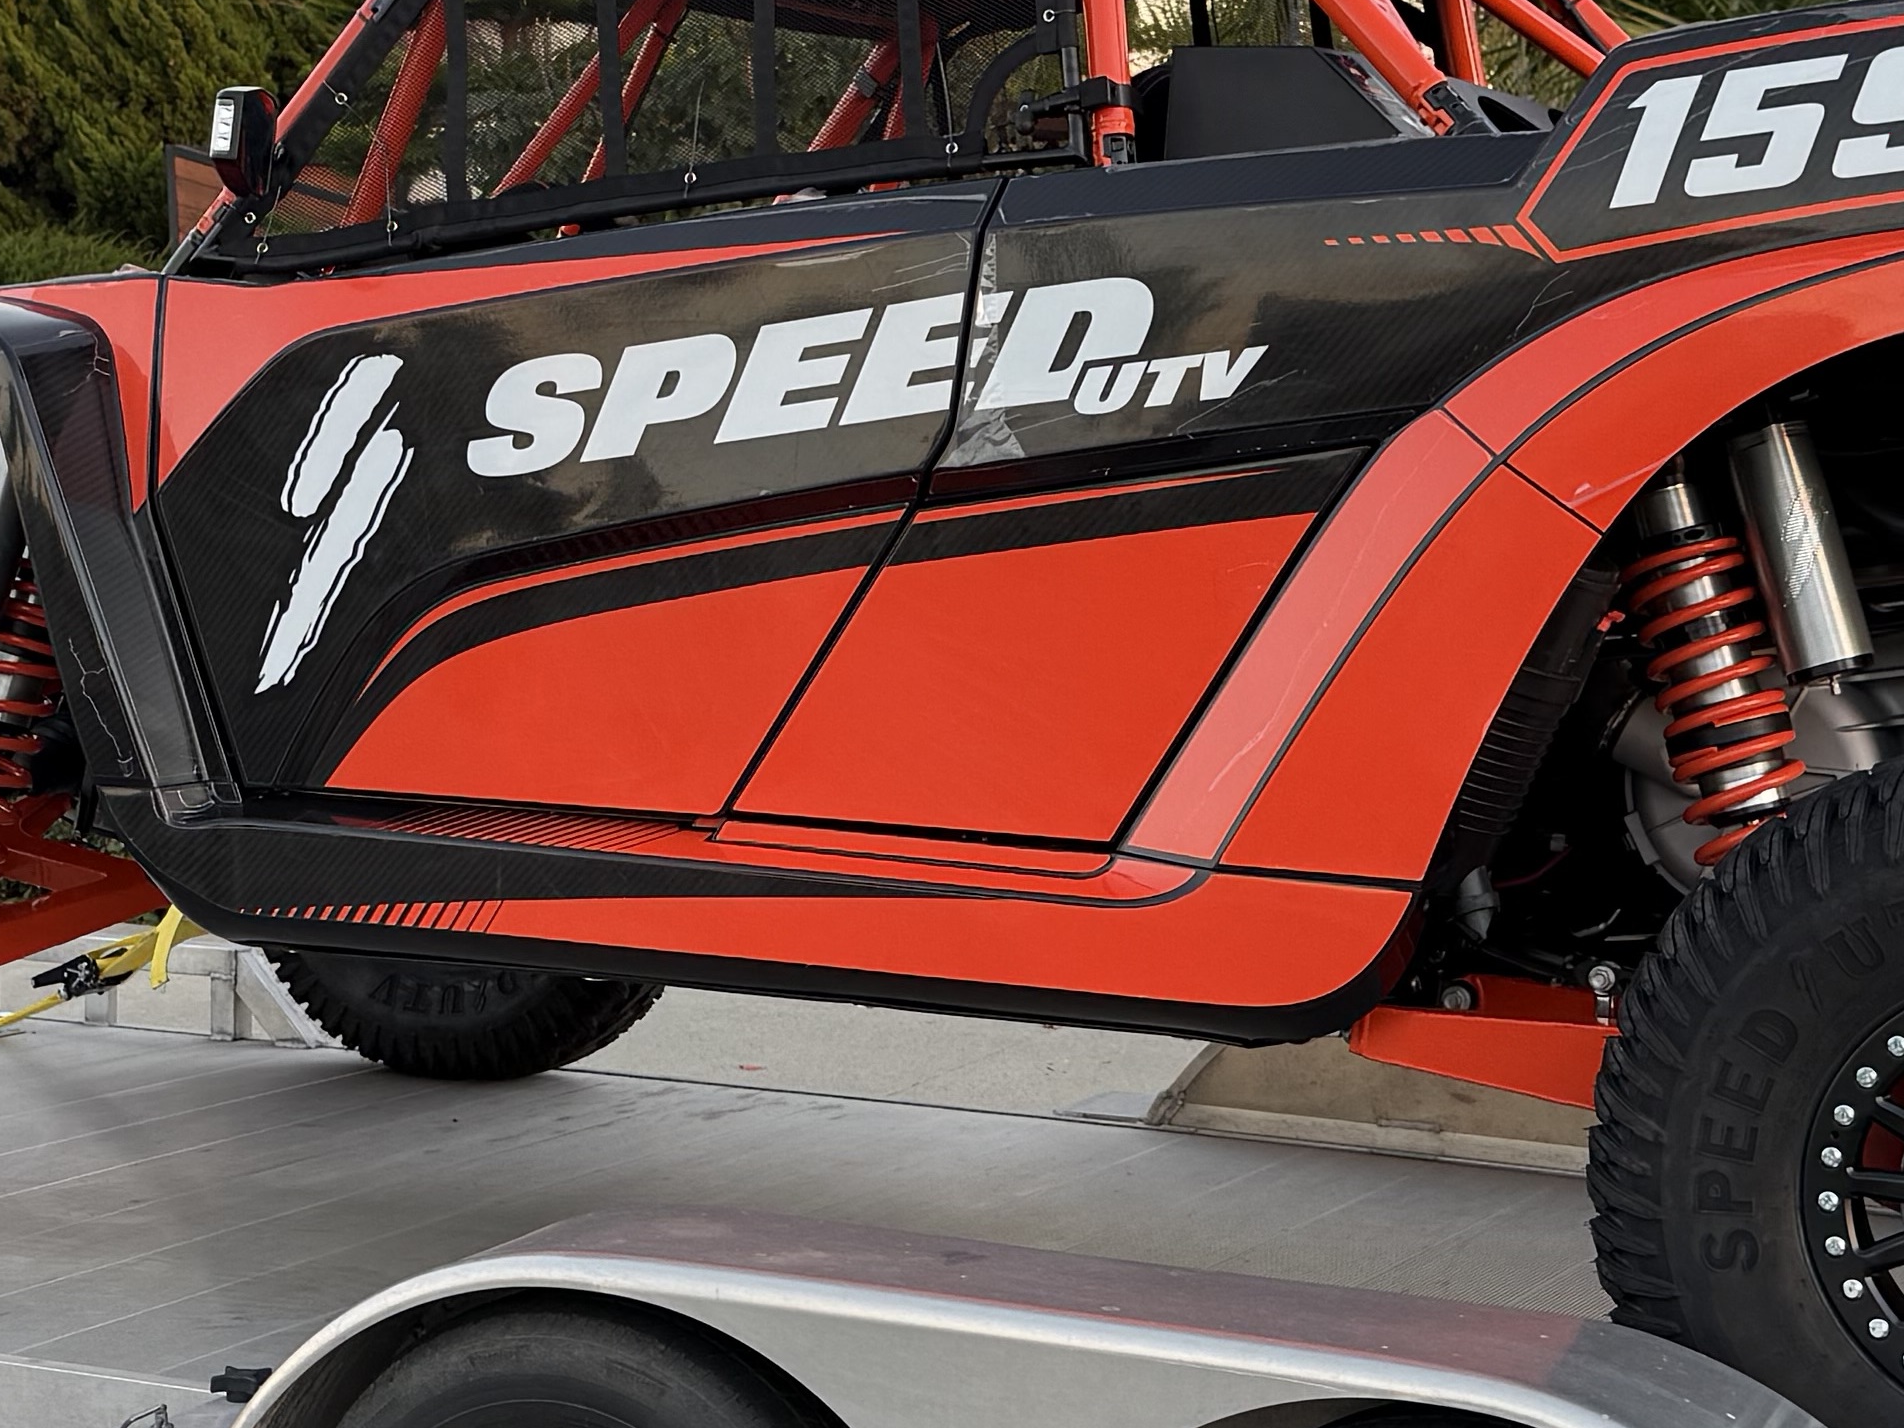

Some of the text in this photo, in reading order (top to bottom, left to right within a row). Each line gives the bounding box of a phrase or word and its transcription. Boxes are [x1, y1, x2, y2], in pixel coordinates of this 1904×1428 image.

[466, 276, 1269, 478] SPEED UTV
[1694, 1008, 1801, 1274] SPEED
